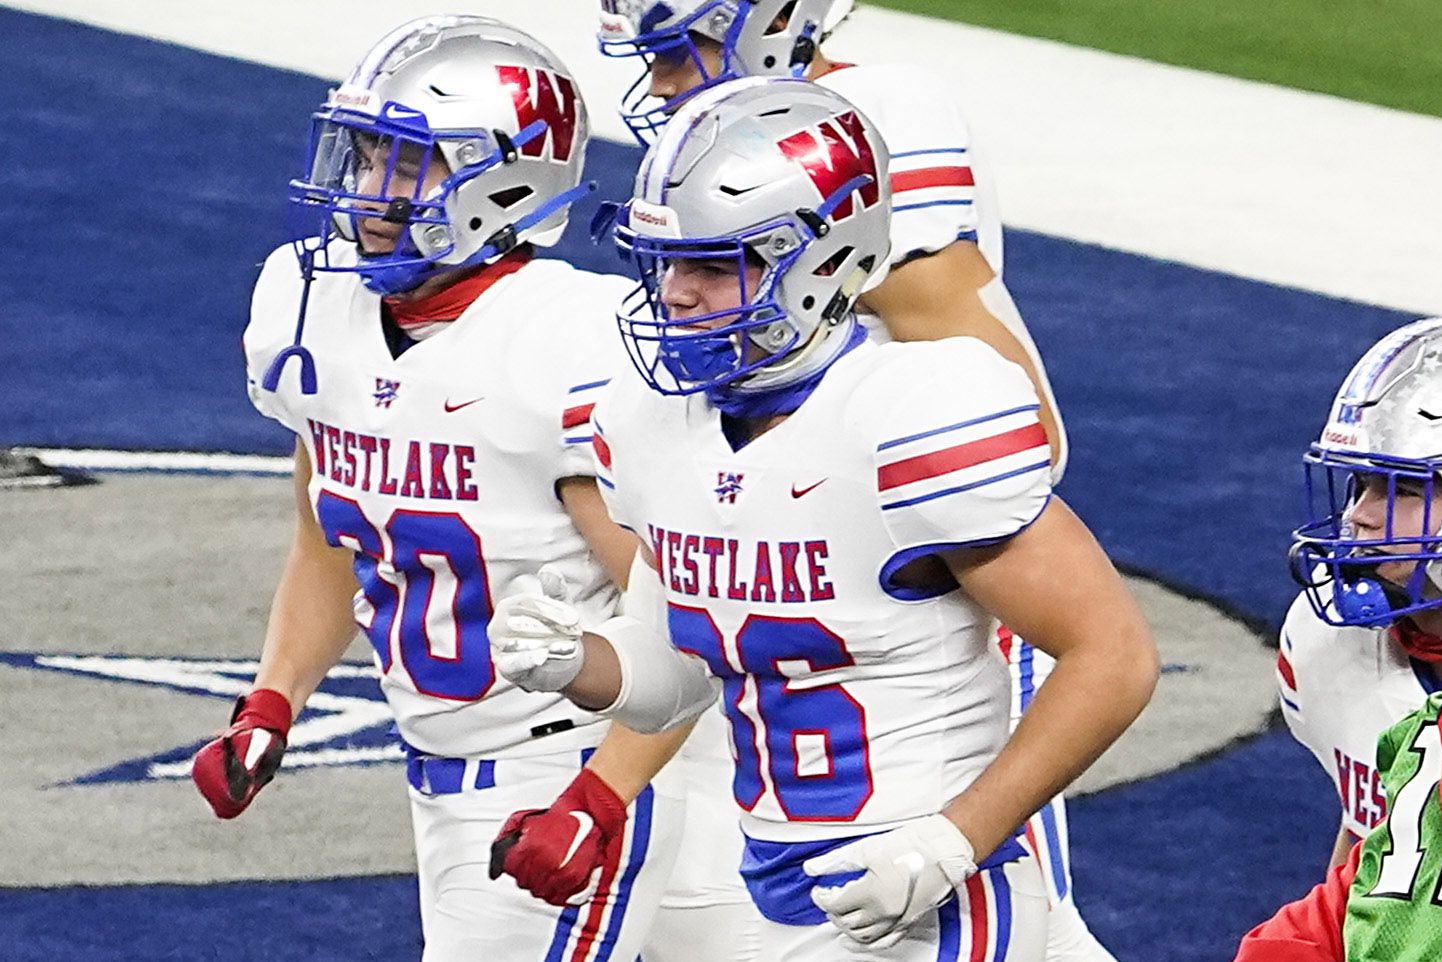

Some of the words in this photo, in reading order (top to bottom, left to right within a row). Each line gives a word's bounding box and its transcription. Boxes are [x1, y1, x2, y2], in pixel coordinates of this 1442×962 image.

[775, 109, 882, 223] W
[306, 417, 479, 502] WESTLAKE
[647, 522, 836, 604] WESTLAKE
